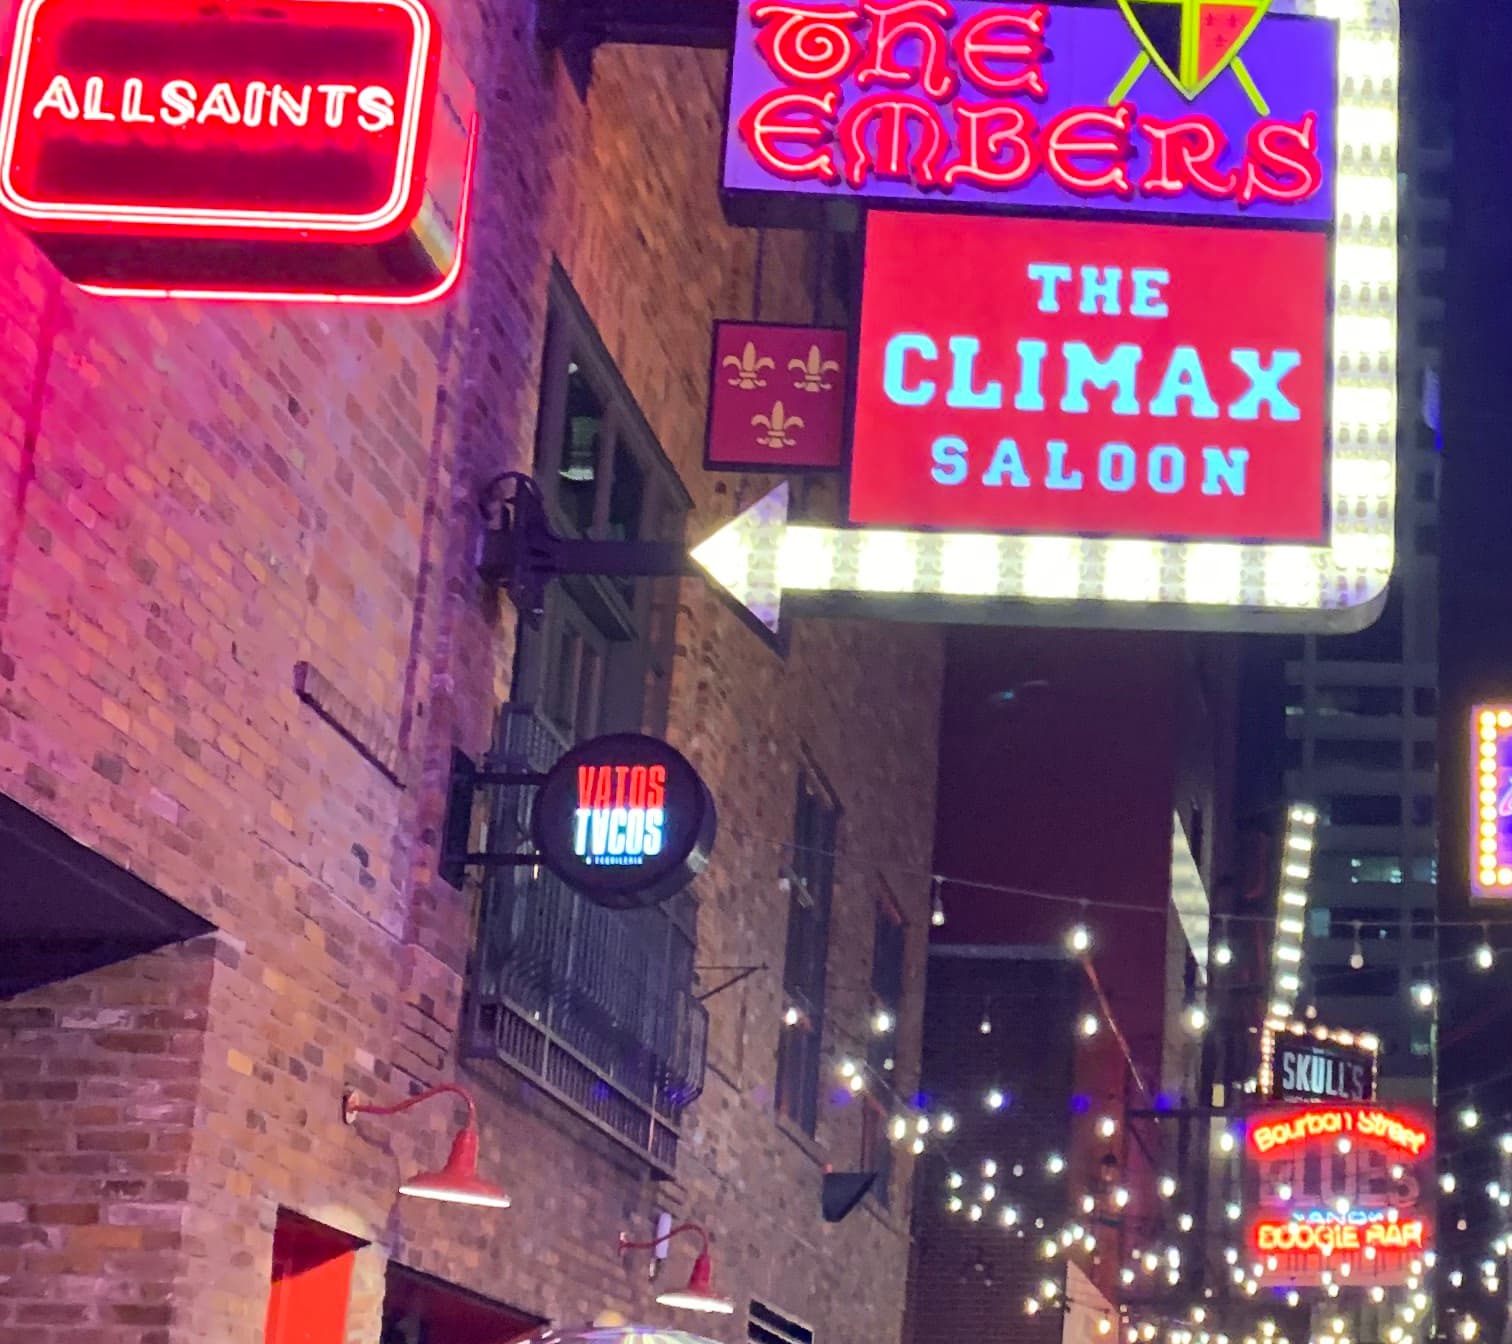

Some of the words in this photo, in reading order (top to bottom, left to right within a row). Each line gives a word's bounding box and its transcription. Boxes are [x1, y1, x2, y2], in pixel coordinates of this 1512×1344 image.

[33, 74, 395, 132] ALLSAINTS
[739, 88, 1323, 207] EMBERS
[1028, 263, 1169, 317] THE
[882, 332, 1300, 421] CLIMAX
[930, 435, 1249, 496] SALOON
[577, 764, 665, 808] VATOS
[1282, 1051, 1365, 1102] SKULL'S
[1254, 1110, 1353, 1153] Bourbon
[1356, 1109, 1426, 1155] Street
[1257, 1223, 1361, 1251] BOOGIE
